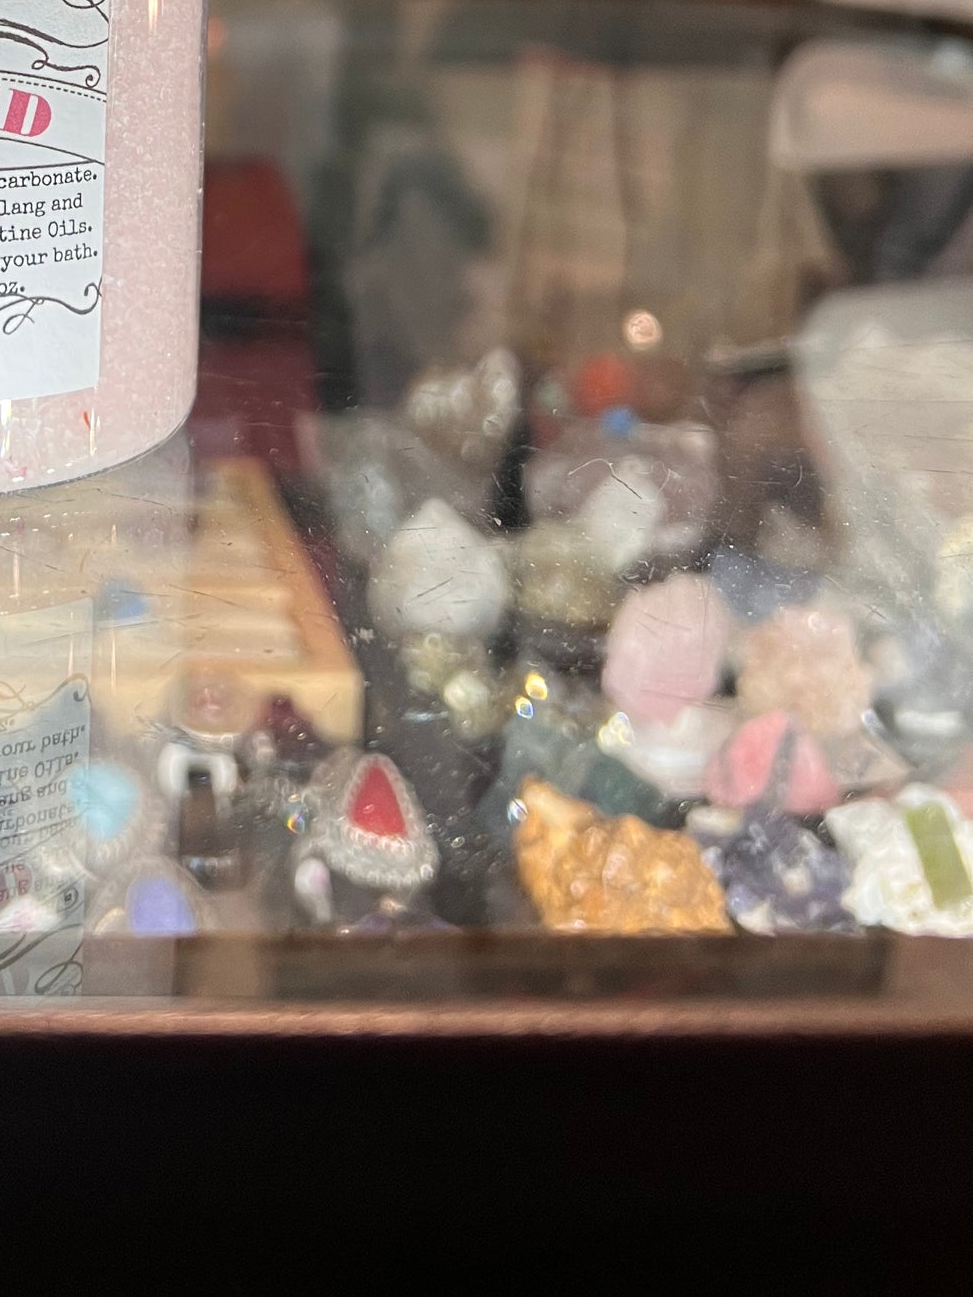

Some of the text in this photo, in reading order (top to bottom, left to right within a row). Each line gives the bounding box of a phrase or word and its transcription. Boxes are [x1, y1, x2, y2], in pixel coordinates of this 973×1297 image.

[51, 194, 82, 211] and
[48, 218, 92, 238] Oils.
[0, 250, 47, 273] your
[53, 242, 98, 263] bath.
